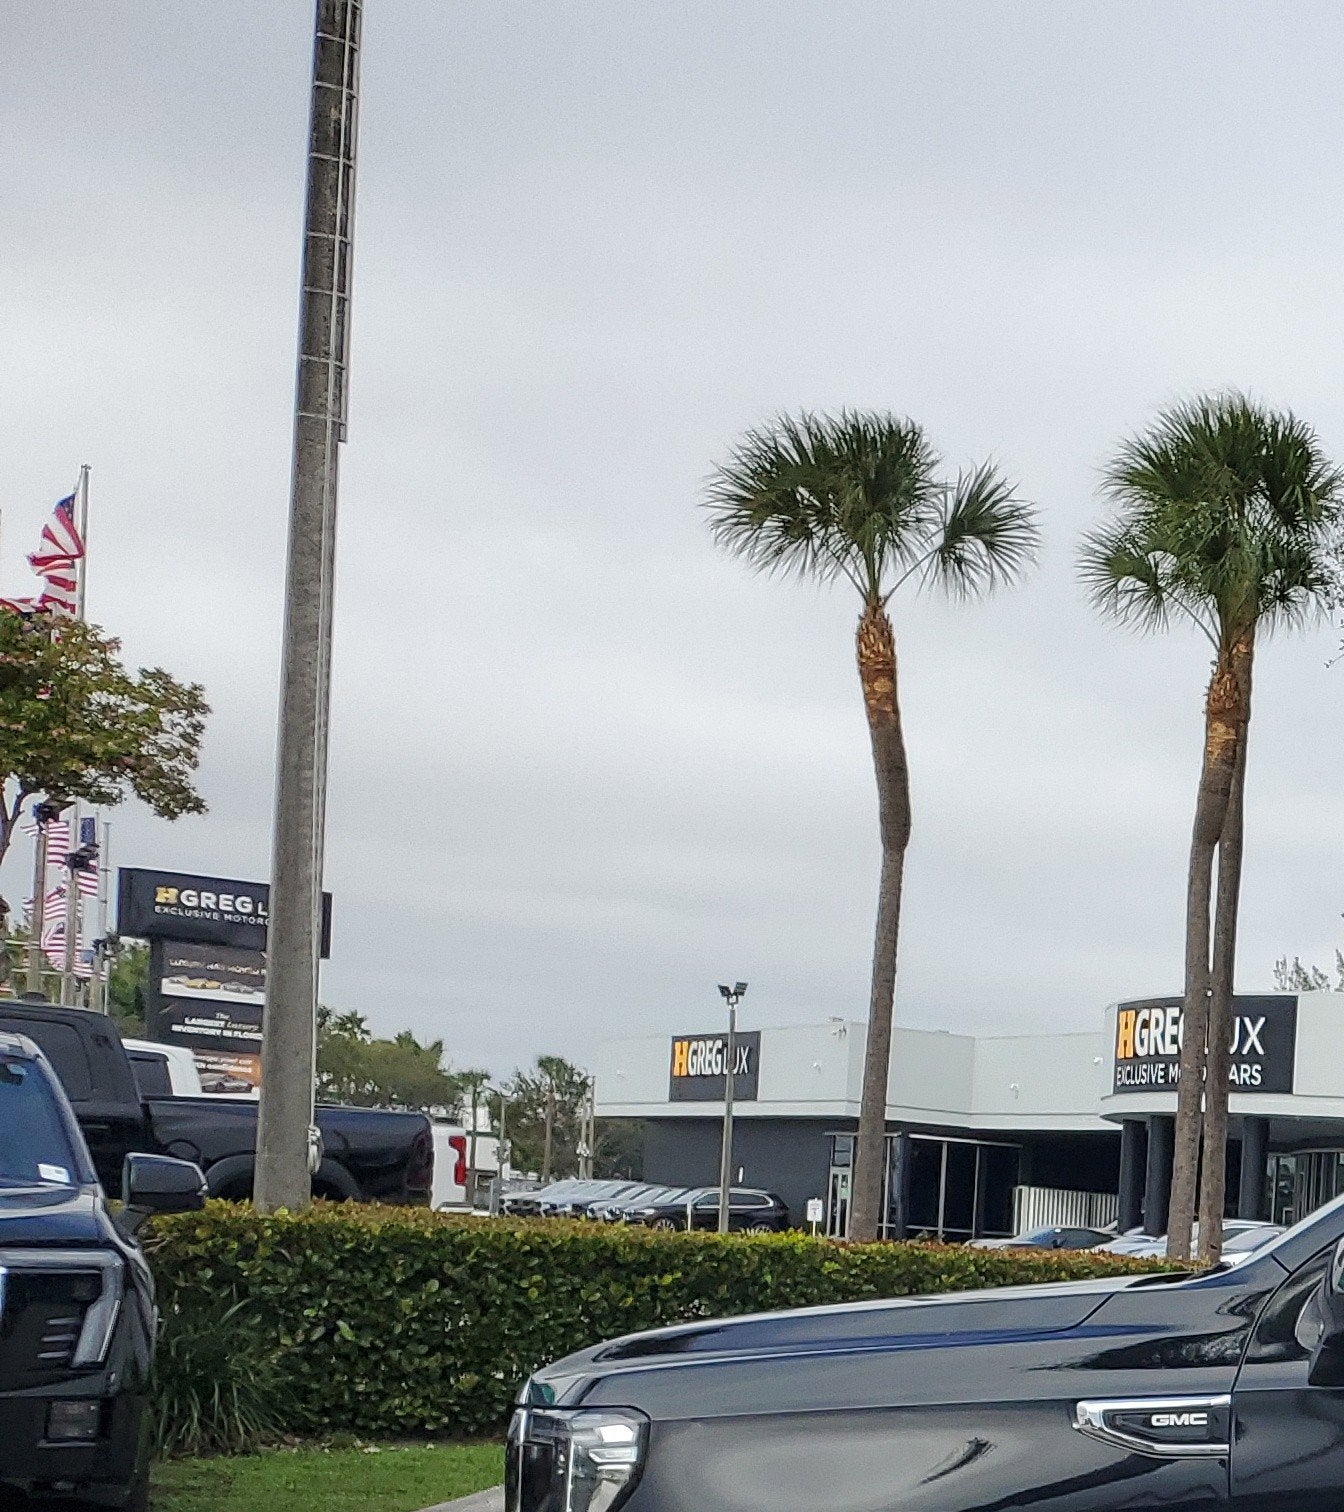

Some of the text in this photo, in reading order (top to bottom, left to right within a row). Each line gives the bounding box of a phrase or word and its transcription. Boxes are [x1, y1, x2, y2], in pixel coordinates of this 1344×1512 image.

[154, 905, 269, 926] EXCLUSIVE MOTOR
[1116, 1006, 1185, 1060] HGRE
[1116, 1062, 1166, 1086] EXCLUSIVE
[1151, 1412, 1208, 1427] GMC
